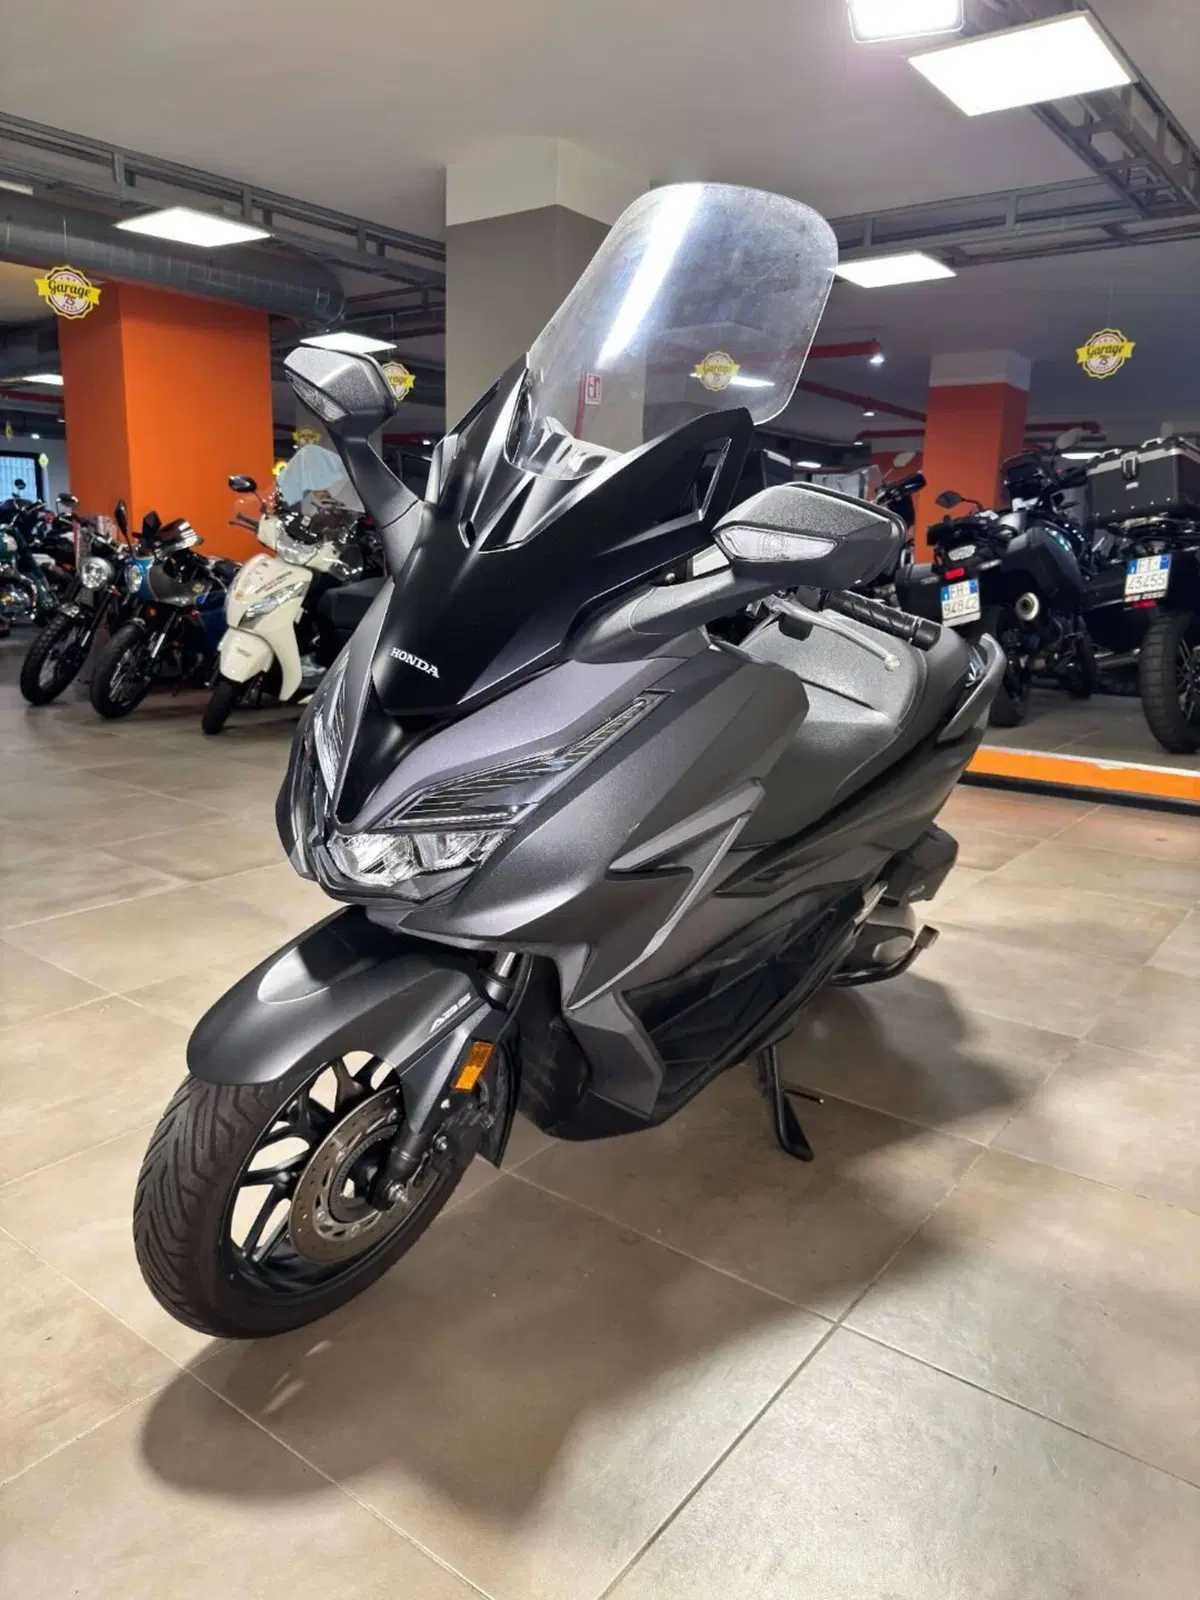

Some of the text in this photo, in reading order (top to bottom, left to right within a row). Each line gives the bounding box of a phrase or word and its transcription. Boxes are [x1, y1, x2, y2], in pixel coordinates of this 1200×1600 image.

[48, 280, 92, 299] Garage
[1086, 344, 1125, 359] Garage
[702, 361, 732, 375] Garage
[950, 584, 964, 598] FH
[390, 647, 440, 679] HONDA
[429, 992, 472, 1033] ABS
